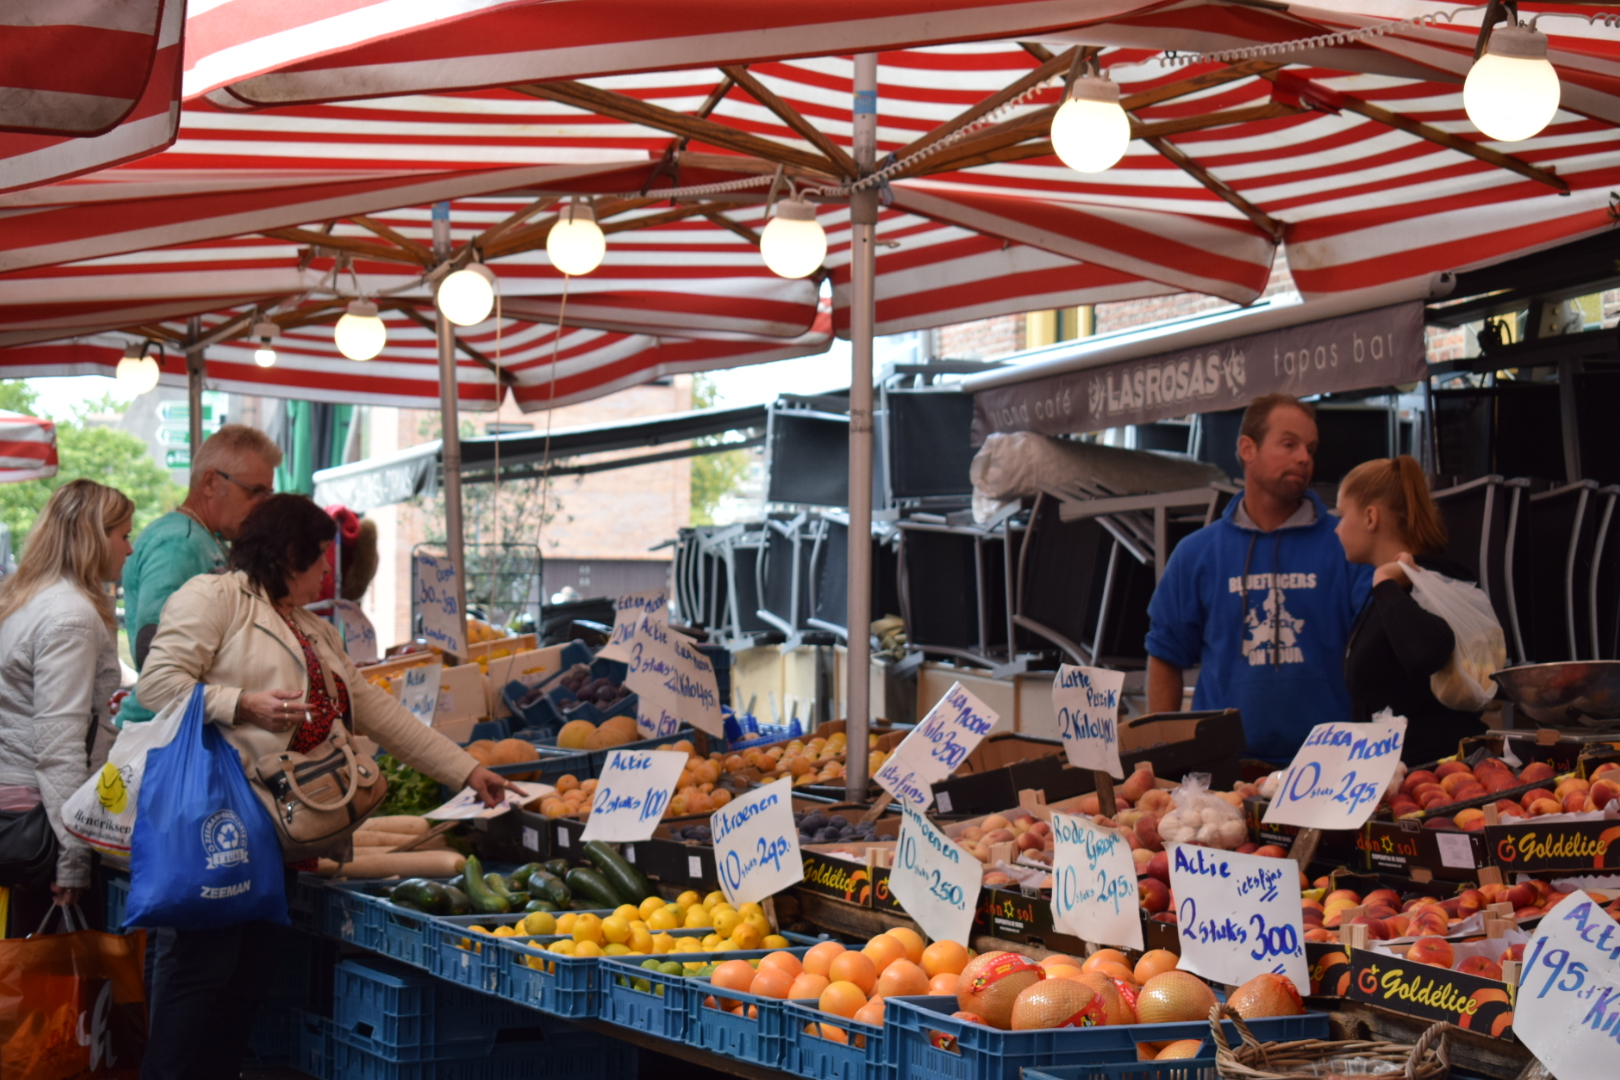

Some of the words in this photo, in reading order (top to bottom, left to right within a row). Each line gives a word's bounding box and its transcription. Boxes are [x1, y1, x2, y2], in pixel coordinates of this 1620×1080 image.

[1035, 388, 1071, 420] café
[1273, 343, 1338, 381] tapas
[1353, 331, 1393, 363] bar
[629, 642, 643, 673] 3
[1248, 648, 1266, 666] ON
[1058, 707, 1073, 740] 2
[1071, 709, 1099, 741] Kilo
[609, 751, 652, 771] Actie
[594, 787, 612, 814] 2
[1275, 761, 1321, 809] 10
[713, 793, 778, 845] Citroenen
[903, 796, 960, 864] Limoenen
[1053, 815, 1086, 844] Rode
[898, 827, 917, 869] 10
[1175, 846, 1231, 878] Actie
[1396, 838, 1419, 856] sol
[1519, 832, 1608, 862] Goldélice
[200, 879, 251, 899] ZEEMAN
[718, 849, 742, 903] 10
[802, 858, 858, 893] Goldélice
[1055, 864, 1077, 919] 10
[1016, 904, 1035, 923] sol
[1180, 897, 1197, 940] 2
[1199, 917, 1248, 945] stuks
[1381, 969, 1478, 1016] Goldélice
